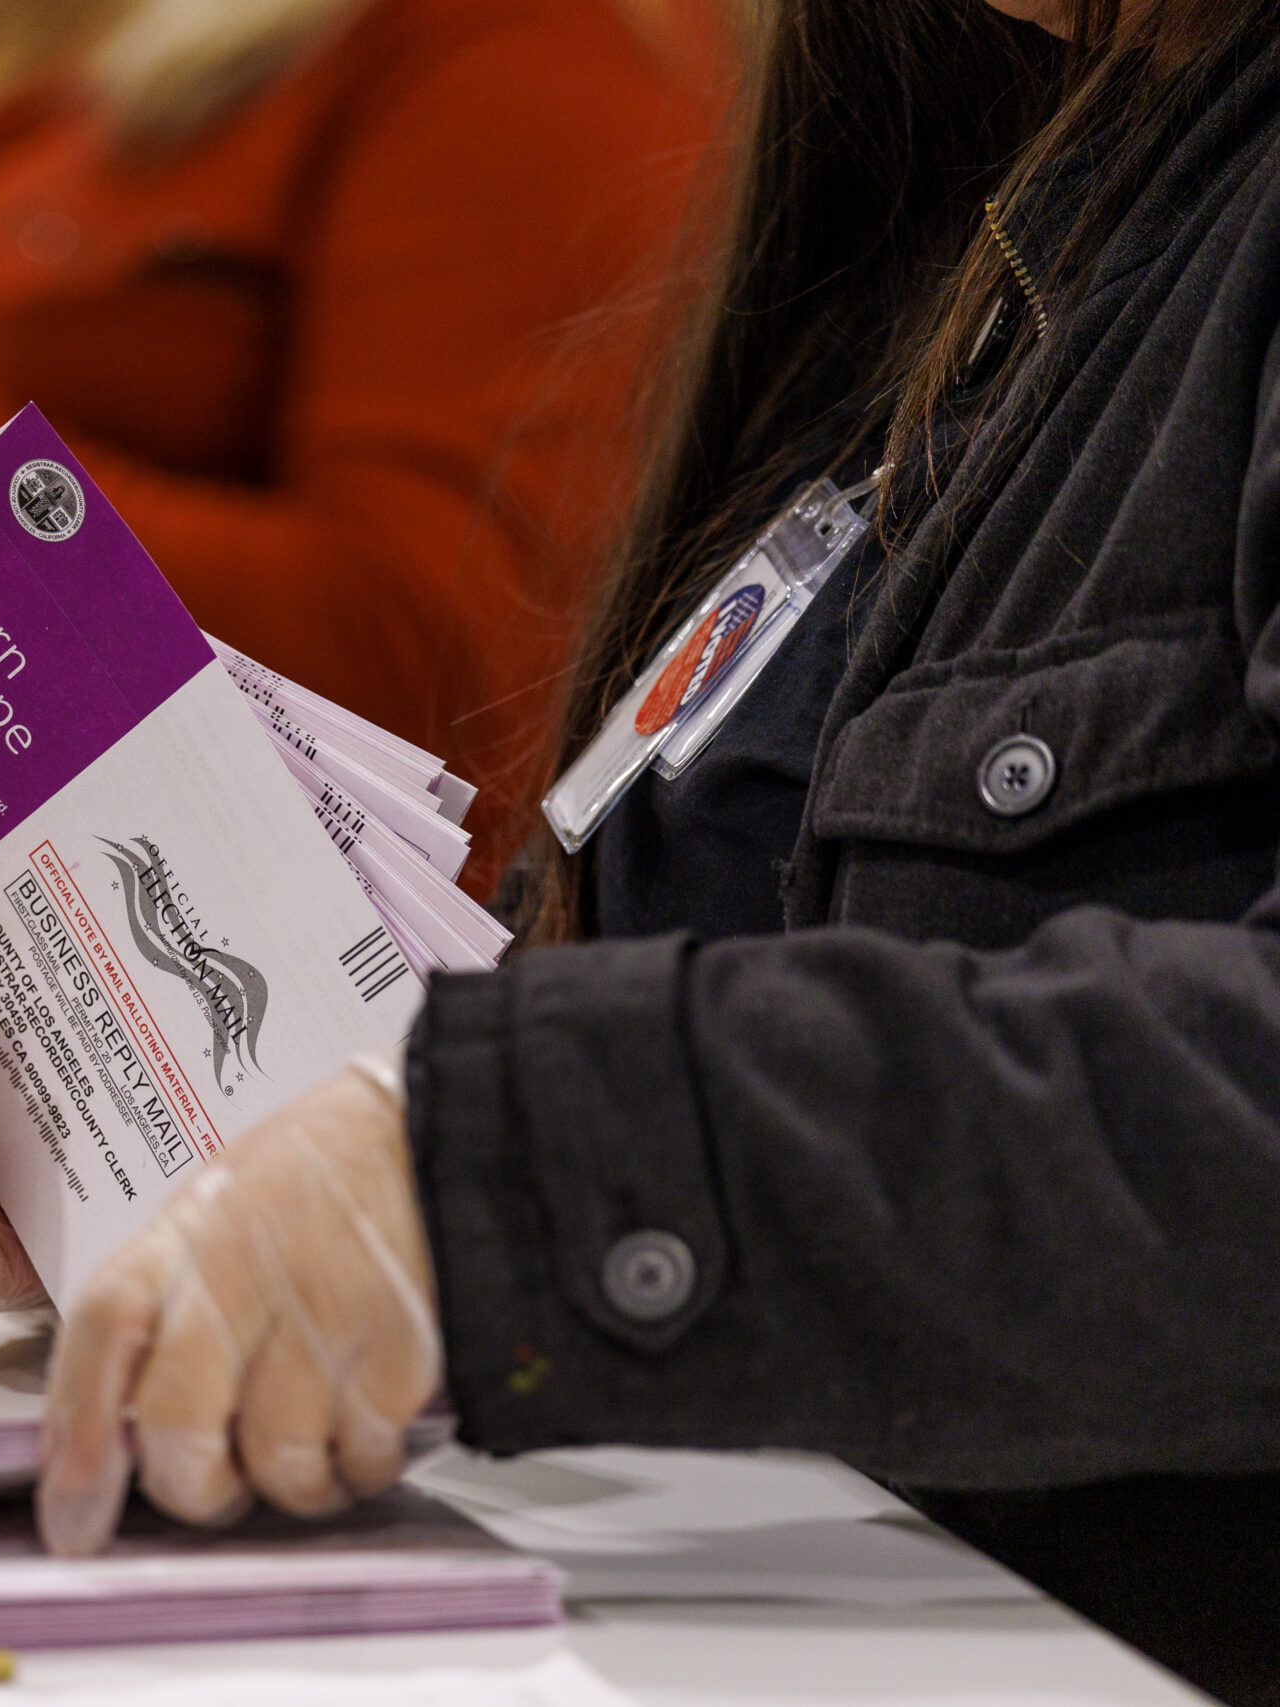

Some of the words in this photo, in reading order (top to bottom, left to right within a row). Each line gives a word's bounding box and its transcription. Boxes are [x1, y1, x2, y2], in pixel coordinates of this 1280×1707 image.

[717, 600, 737, 619] I
[679, 616, 731, 704] VOTED
[10, 890, 49, 951] FIRST-CLASS
[44, 950, 60, 975] MAIL
[146, 843, 210, 941] OFFICIAL
[40, 853, 75, 909] OFFICIAL
[73, 907, 97, 943] VOTE
[92, 941, 108, 959] BY
[103, 960, 123, 993] MAIL
[120, 991, 164, 1062] BALLOTING
[160, 1061, 197, 1125] MATERIAL
[136, 866, 215, 981] ELECTION
[206, 983, 246, 1044] MAIL
[157, 931, 183, 969] Authorized
[177, 967, 189, 980] by
[184, 978, 196, 991] the
[191, 990, 204, 1005] U.S.
[200, 1006, 217, 1028] Postal
[212, 1027, 231, 1053] Service
[0, 992, 27, 1033] 30450
[18, 877, 99, 1007] BUSINESS
[93, 1009, 150, 1090] REPLY
[142, 1094, 191, 1161] MAIL
[20, 973, 38, 993] OF
[32, 995, 55, 1028] LOS
[50, 1029, 94, 1097] ANGELES
[27, 945, 58, 992] POSTAGE
[54, 990, 69, 1016] WILL
[66, 1014, 79, 1030] BE
[75, 1029, 92, 1053] PAID
[88, 1052, 101, 1066] BY
[95, 1068, 133, 1127] ADDRESSEE
[70, 996, 95, 1032] PERMIT
[90, 1031, 103, 1049] NO.
[100, 1050, 112, 1064] 20
[11, 1039, 27, 1063] CA
[23, 1062, 71, 1139] 90099-9823
[119, 1083, 135, 1105] LOS
[130, 1105, 160, 1153] ANGELES,
[157, 1151, 169, 1168] CA
[104, 1150, 137, 1201] CLERK
